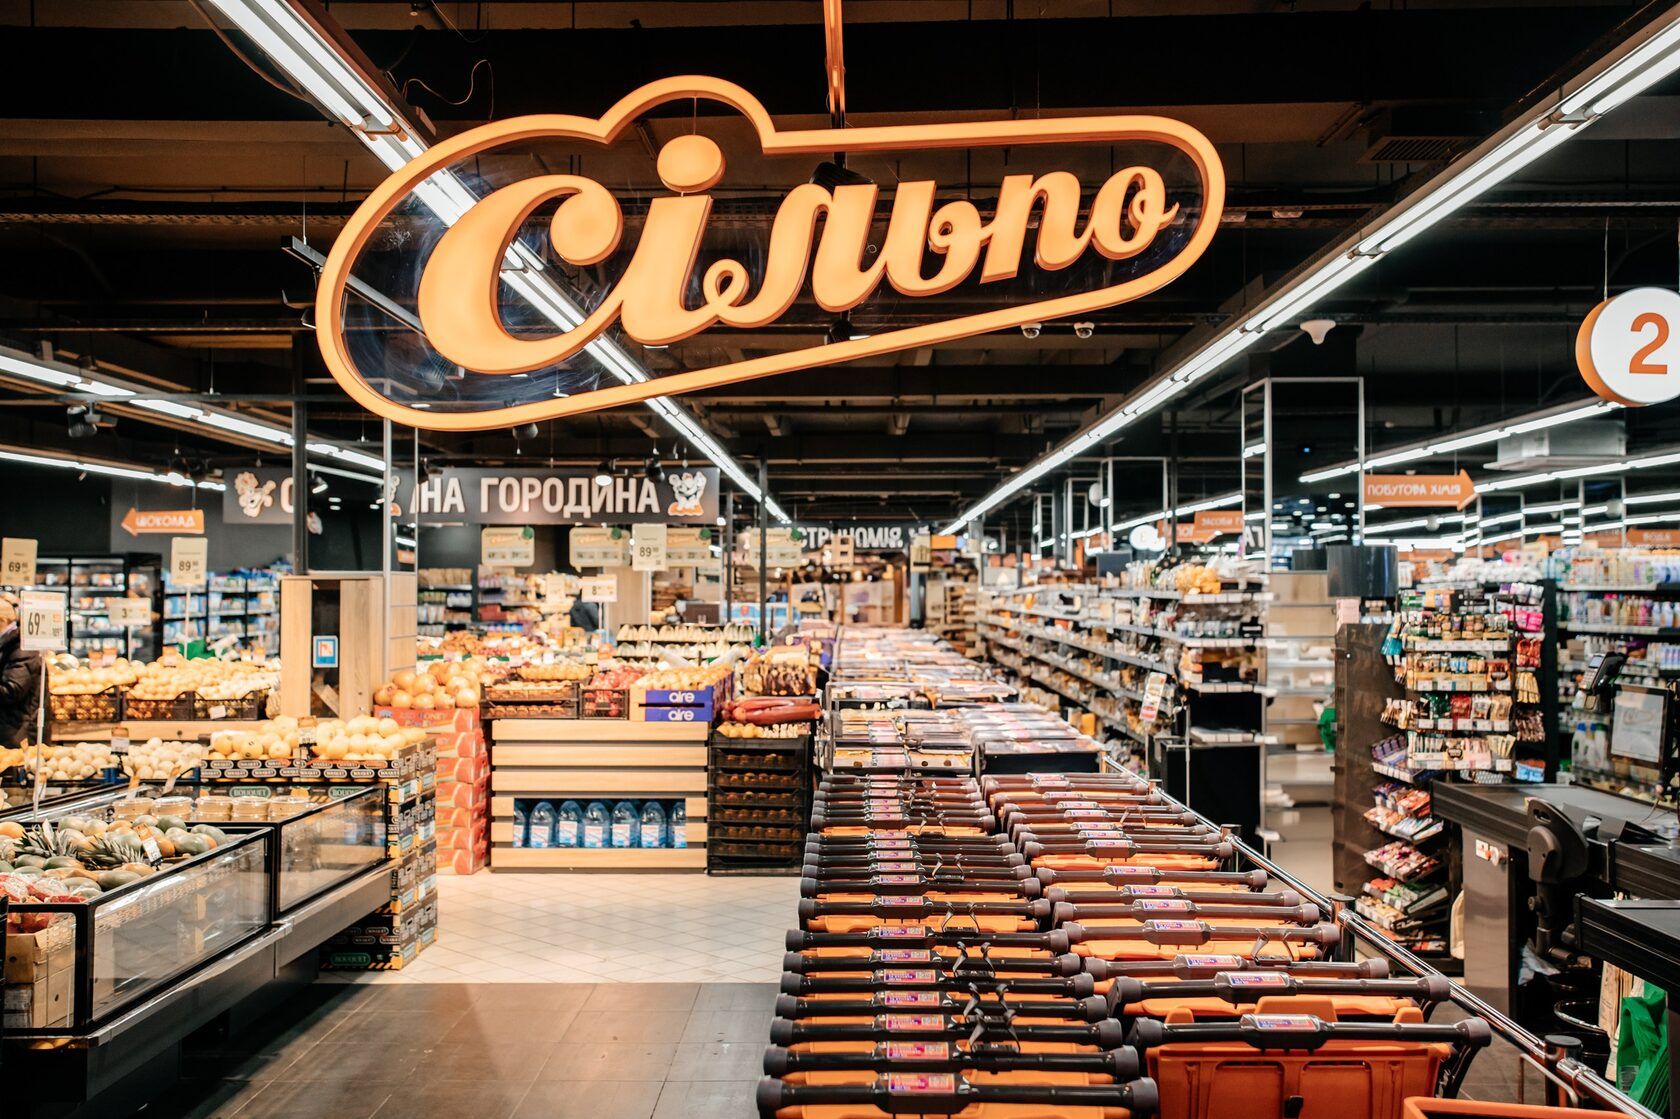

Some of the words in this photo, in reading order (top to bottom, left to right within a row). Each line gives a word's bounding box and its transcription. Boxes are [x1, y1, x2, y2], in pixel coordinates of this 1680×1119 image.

[418, 135, 1180, 373] Сільпо
[1629, 312, 1669, 374] 2
[1430, 483, 1461, 496] ХІМІЯ
[480, 476, 660, 518] ГОРОДИНА
[136, 515, 195, 528] ШОКОЛАД
[639, 546, 652, 557] 89
[8, 561, 20, 572] 69
[178, 561, 191, 571] 89
[27, 612, 41, 636] 69
[233, 788, 266, 797] BOUQUET
